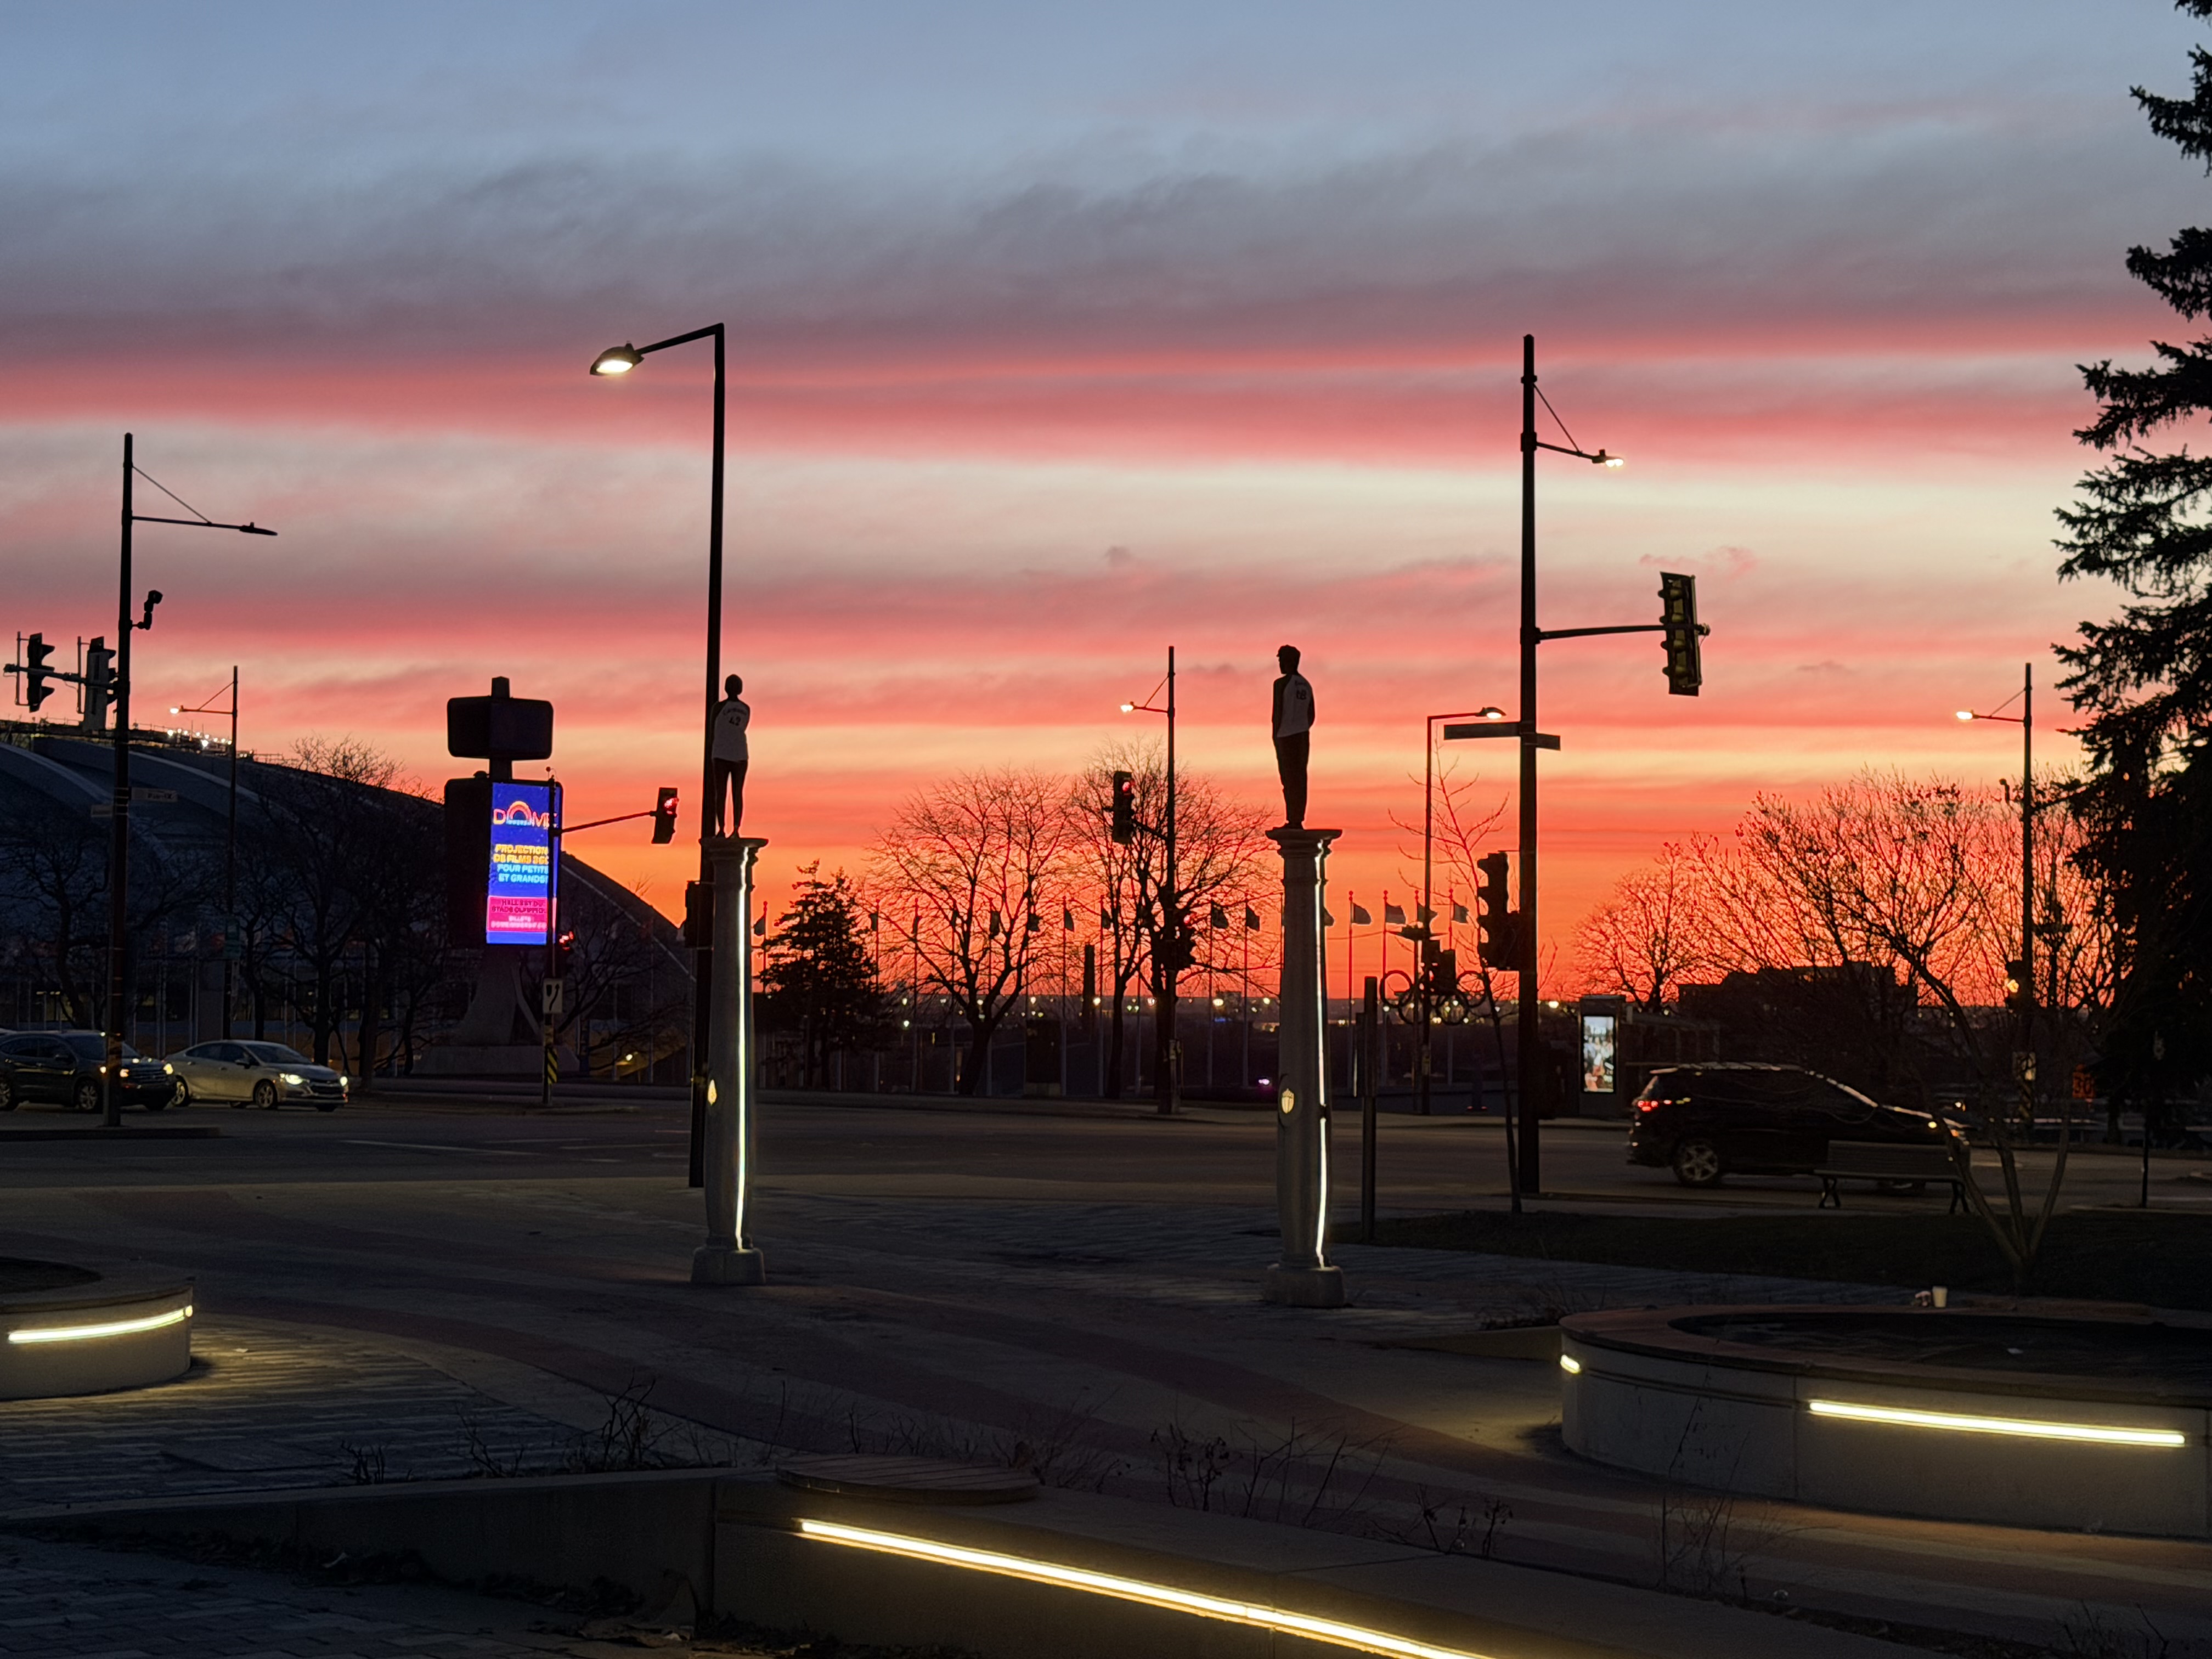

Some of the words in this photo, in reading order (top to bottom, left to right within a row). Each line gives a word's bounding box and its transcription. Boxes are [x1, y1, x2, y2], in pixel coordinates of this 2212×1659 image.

[493, 853, 506, 863] DE
[506, 854, 532, 864] FILMS
[497, 864, 521, 872] POUR
[498, 873, 510, 882] ET
